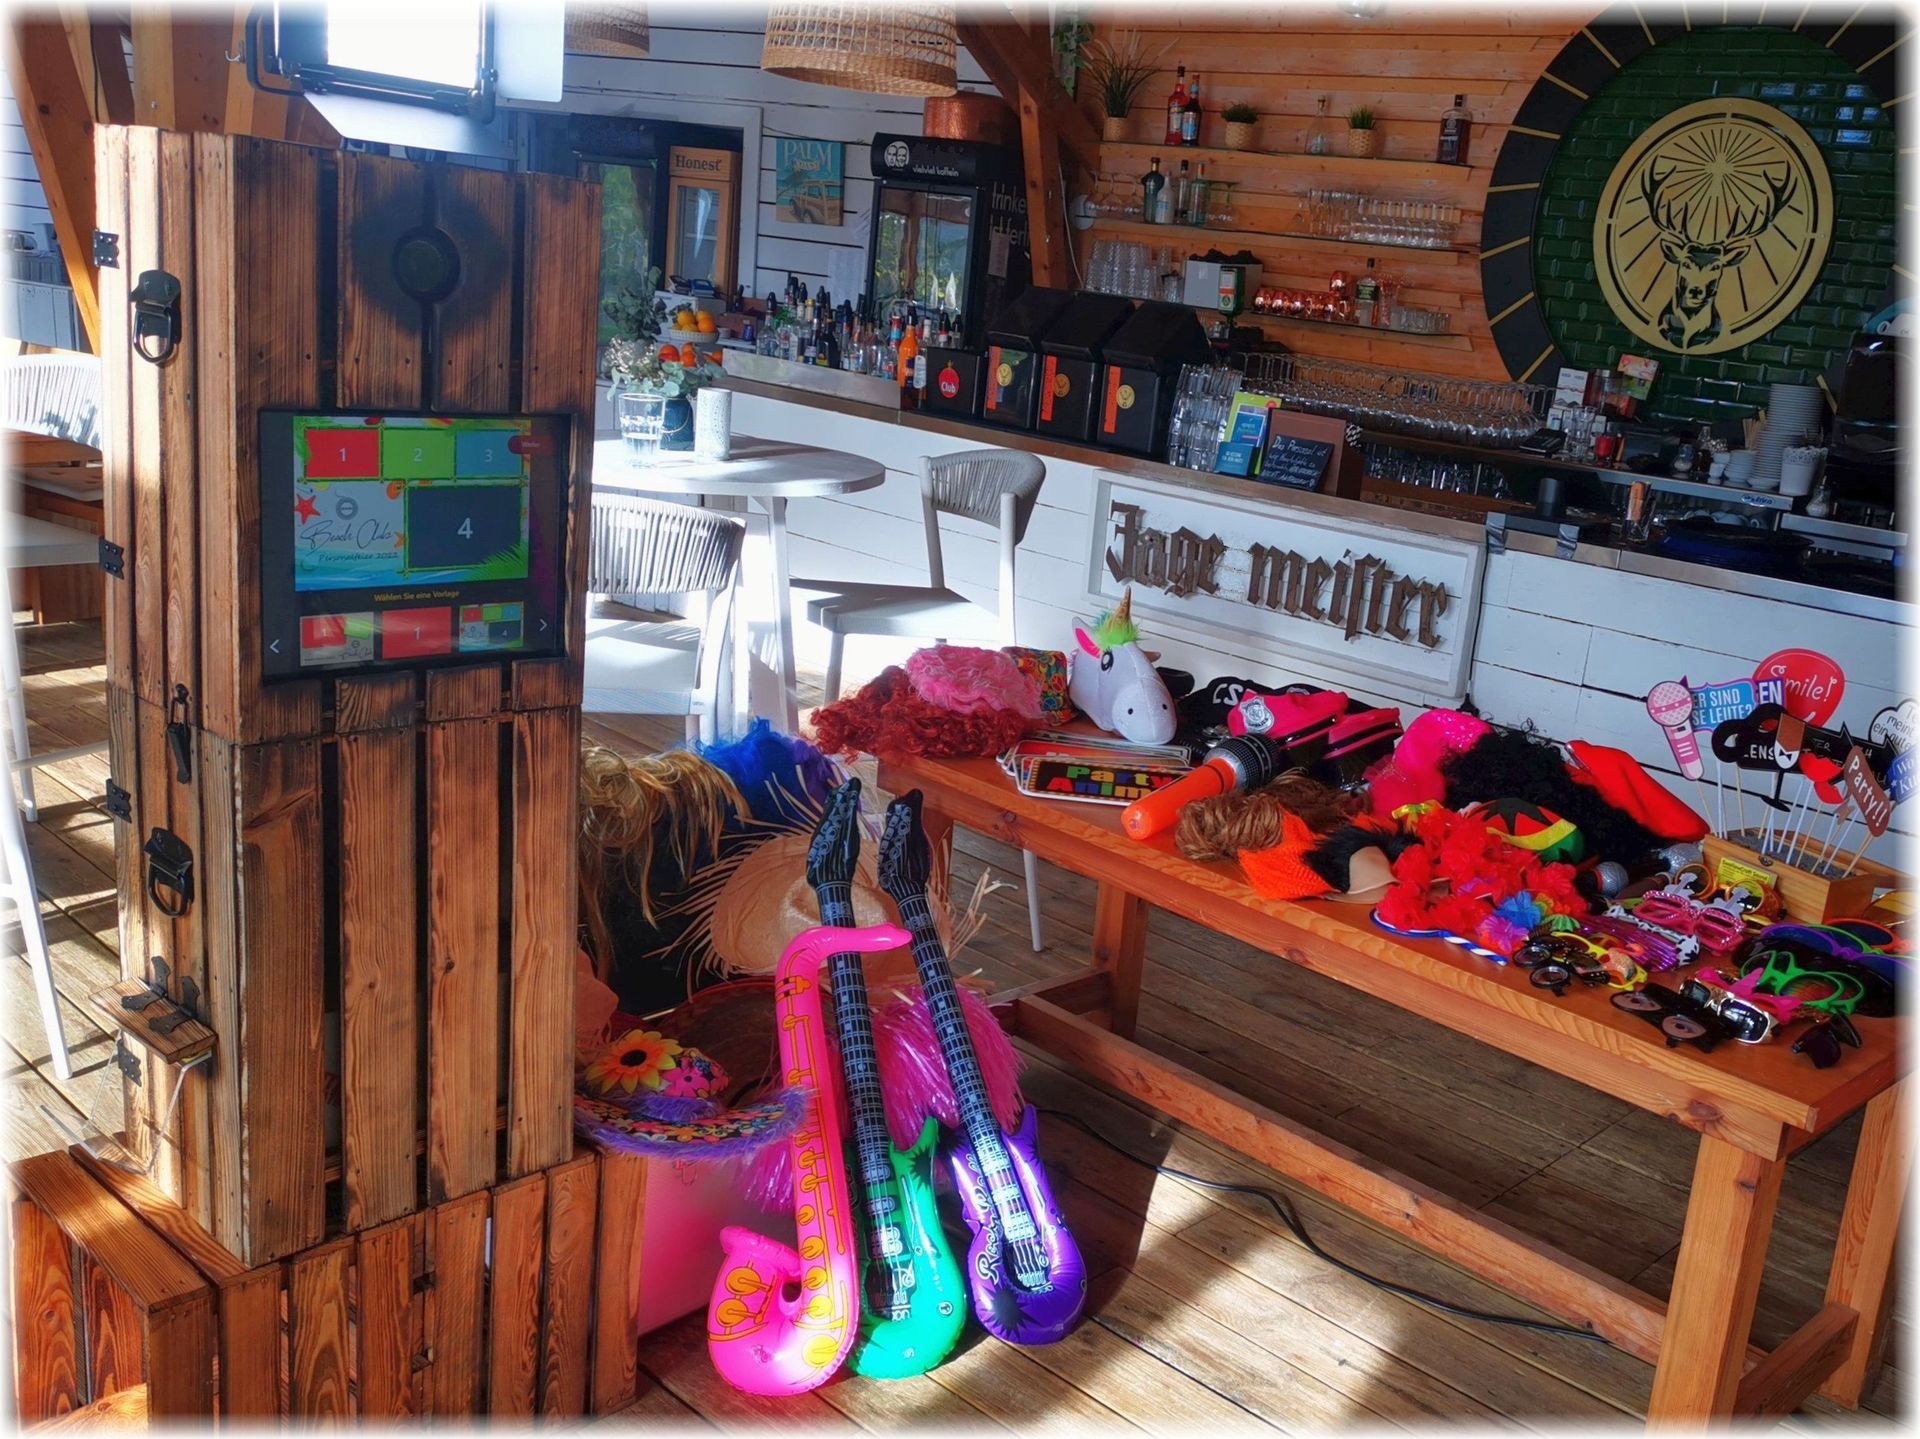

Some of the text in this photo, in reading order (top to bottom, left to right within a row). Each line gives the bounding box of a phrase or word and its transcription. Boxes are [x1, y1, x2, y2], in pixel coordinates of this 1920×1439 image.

[783, 140, 833, 172] PALM
[941, 381, 956, 393] Club
[339, 448, 493, 462] 1 2 3
[457, 517, 473, 539] 4
[413, 625, 421, 640] 1
[1692, 688, 1740, 708] ER SIND
[1067, 765, 1173, 788] Party
[1047, 776, 1153, 801] Anim
[1849, 755, 1888, 827] Party!!
